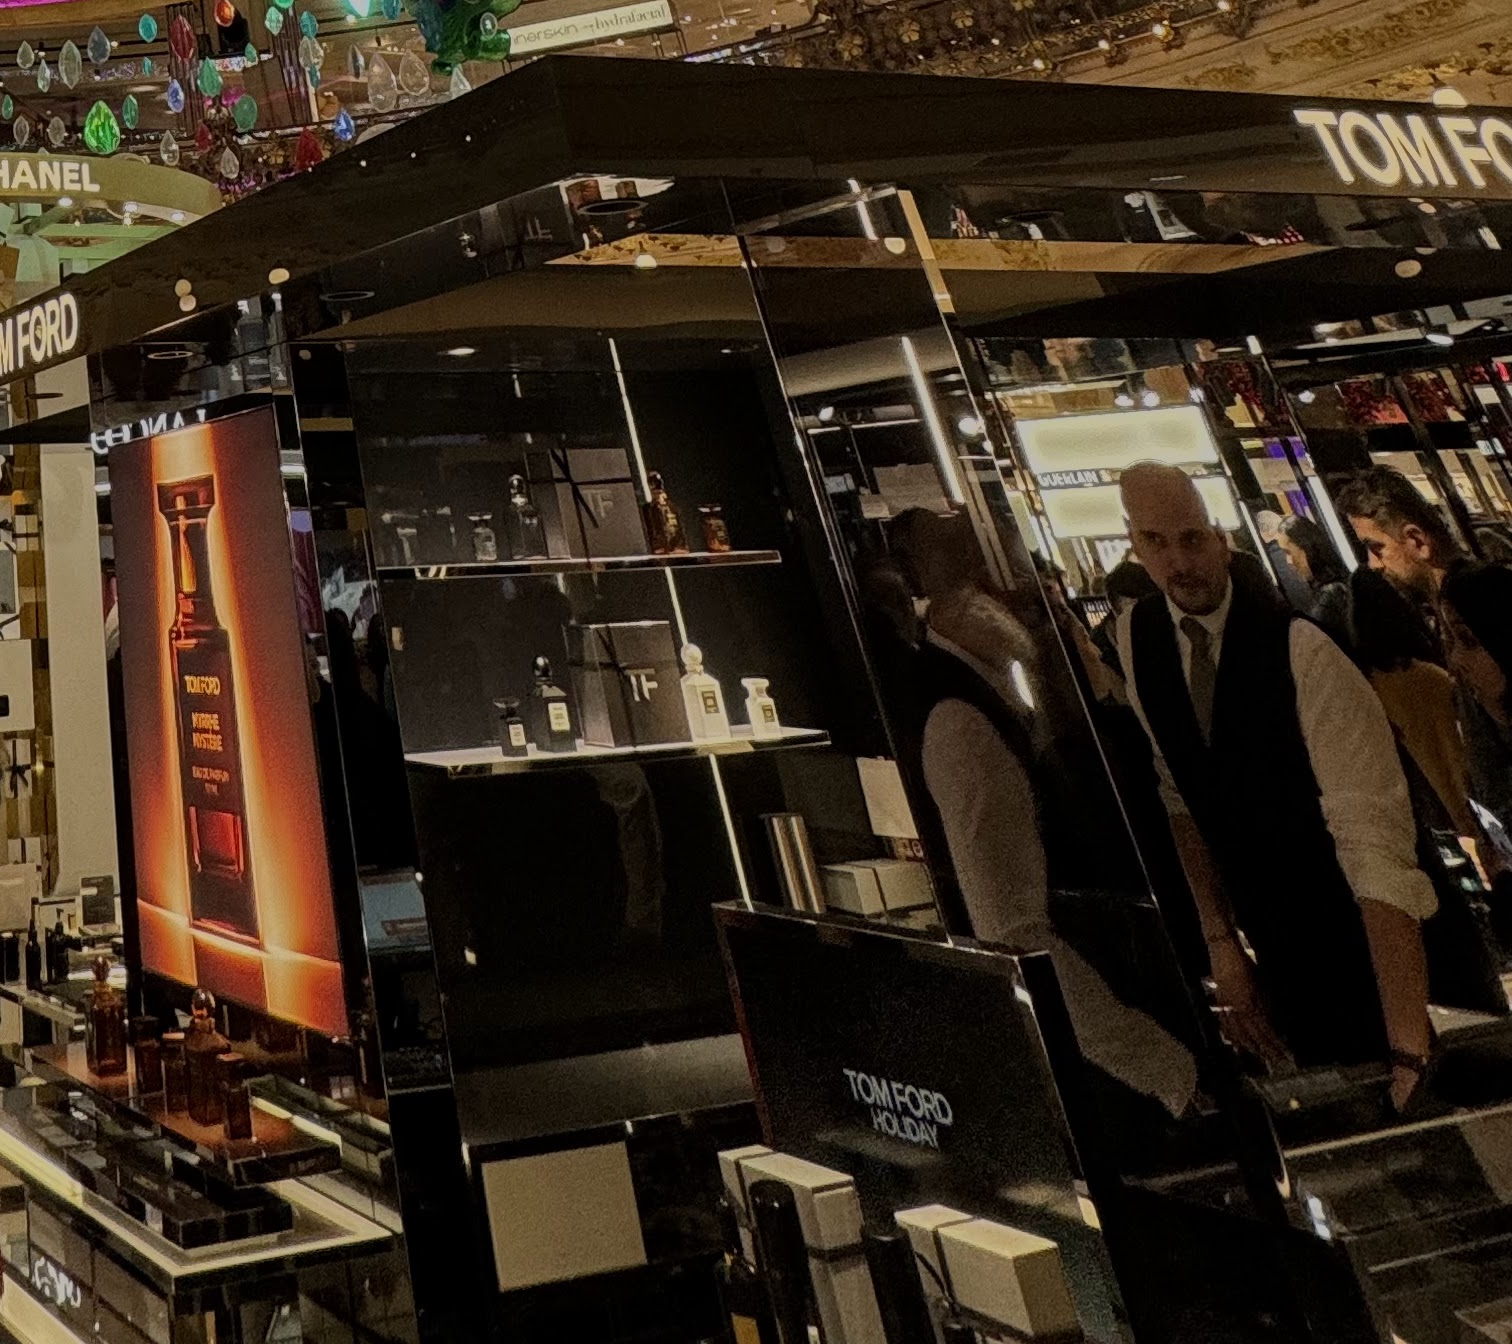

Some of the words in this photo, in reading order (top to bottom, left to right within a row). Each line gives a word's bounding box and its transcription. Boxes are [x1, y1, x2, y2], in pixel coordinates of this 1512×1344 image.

[595, 5, 666, 31] hydrafacial
[1293, 109, 1458, 187] TOM
[16, 292, 79, 369] FORD
[624, 668, 659, 702] TF
[842, 1068, 894, 1111] TOM
[890, 1080, 953, 1126] FORD
[870, 1107, 940, 1151] HOLIDAY
